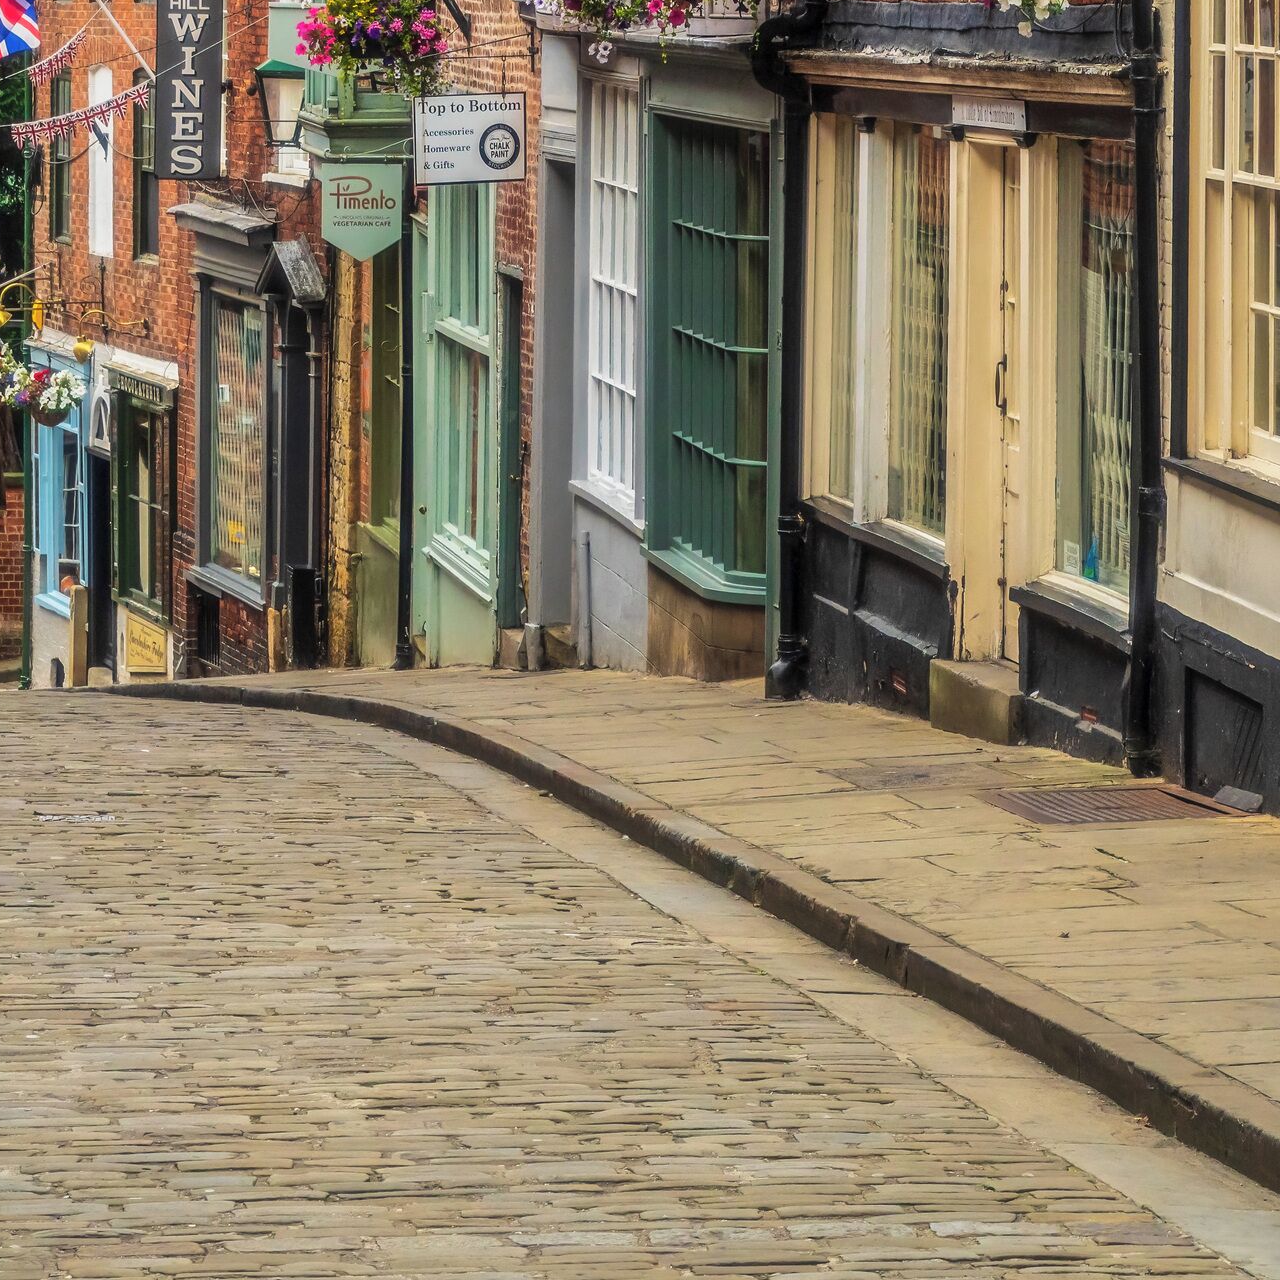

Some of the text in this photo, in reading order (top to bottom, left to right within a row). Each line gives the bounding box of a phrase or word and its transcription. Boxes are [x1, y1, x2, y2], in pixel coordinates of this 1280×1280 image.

[168, 13, 210, 176] WINES
[418, 99, 522, 117] Top to Bottom
[422, 127, 475, 138] Accessories
[423, 144, 471, 154] Homeware
[489, 141, 511, 151] CHALK
[490, 150, 509, 159] PAINT
[423, 160, 455, 170] & Gifts
[328, 175, 397, 210] Pimento
